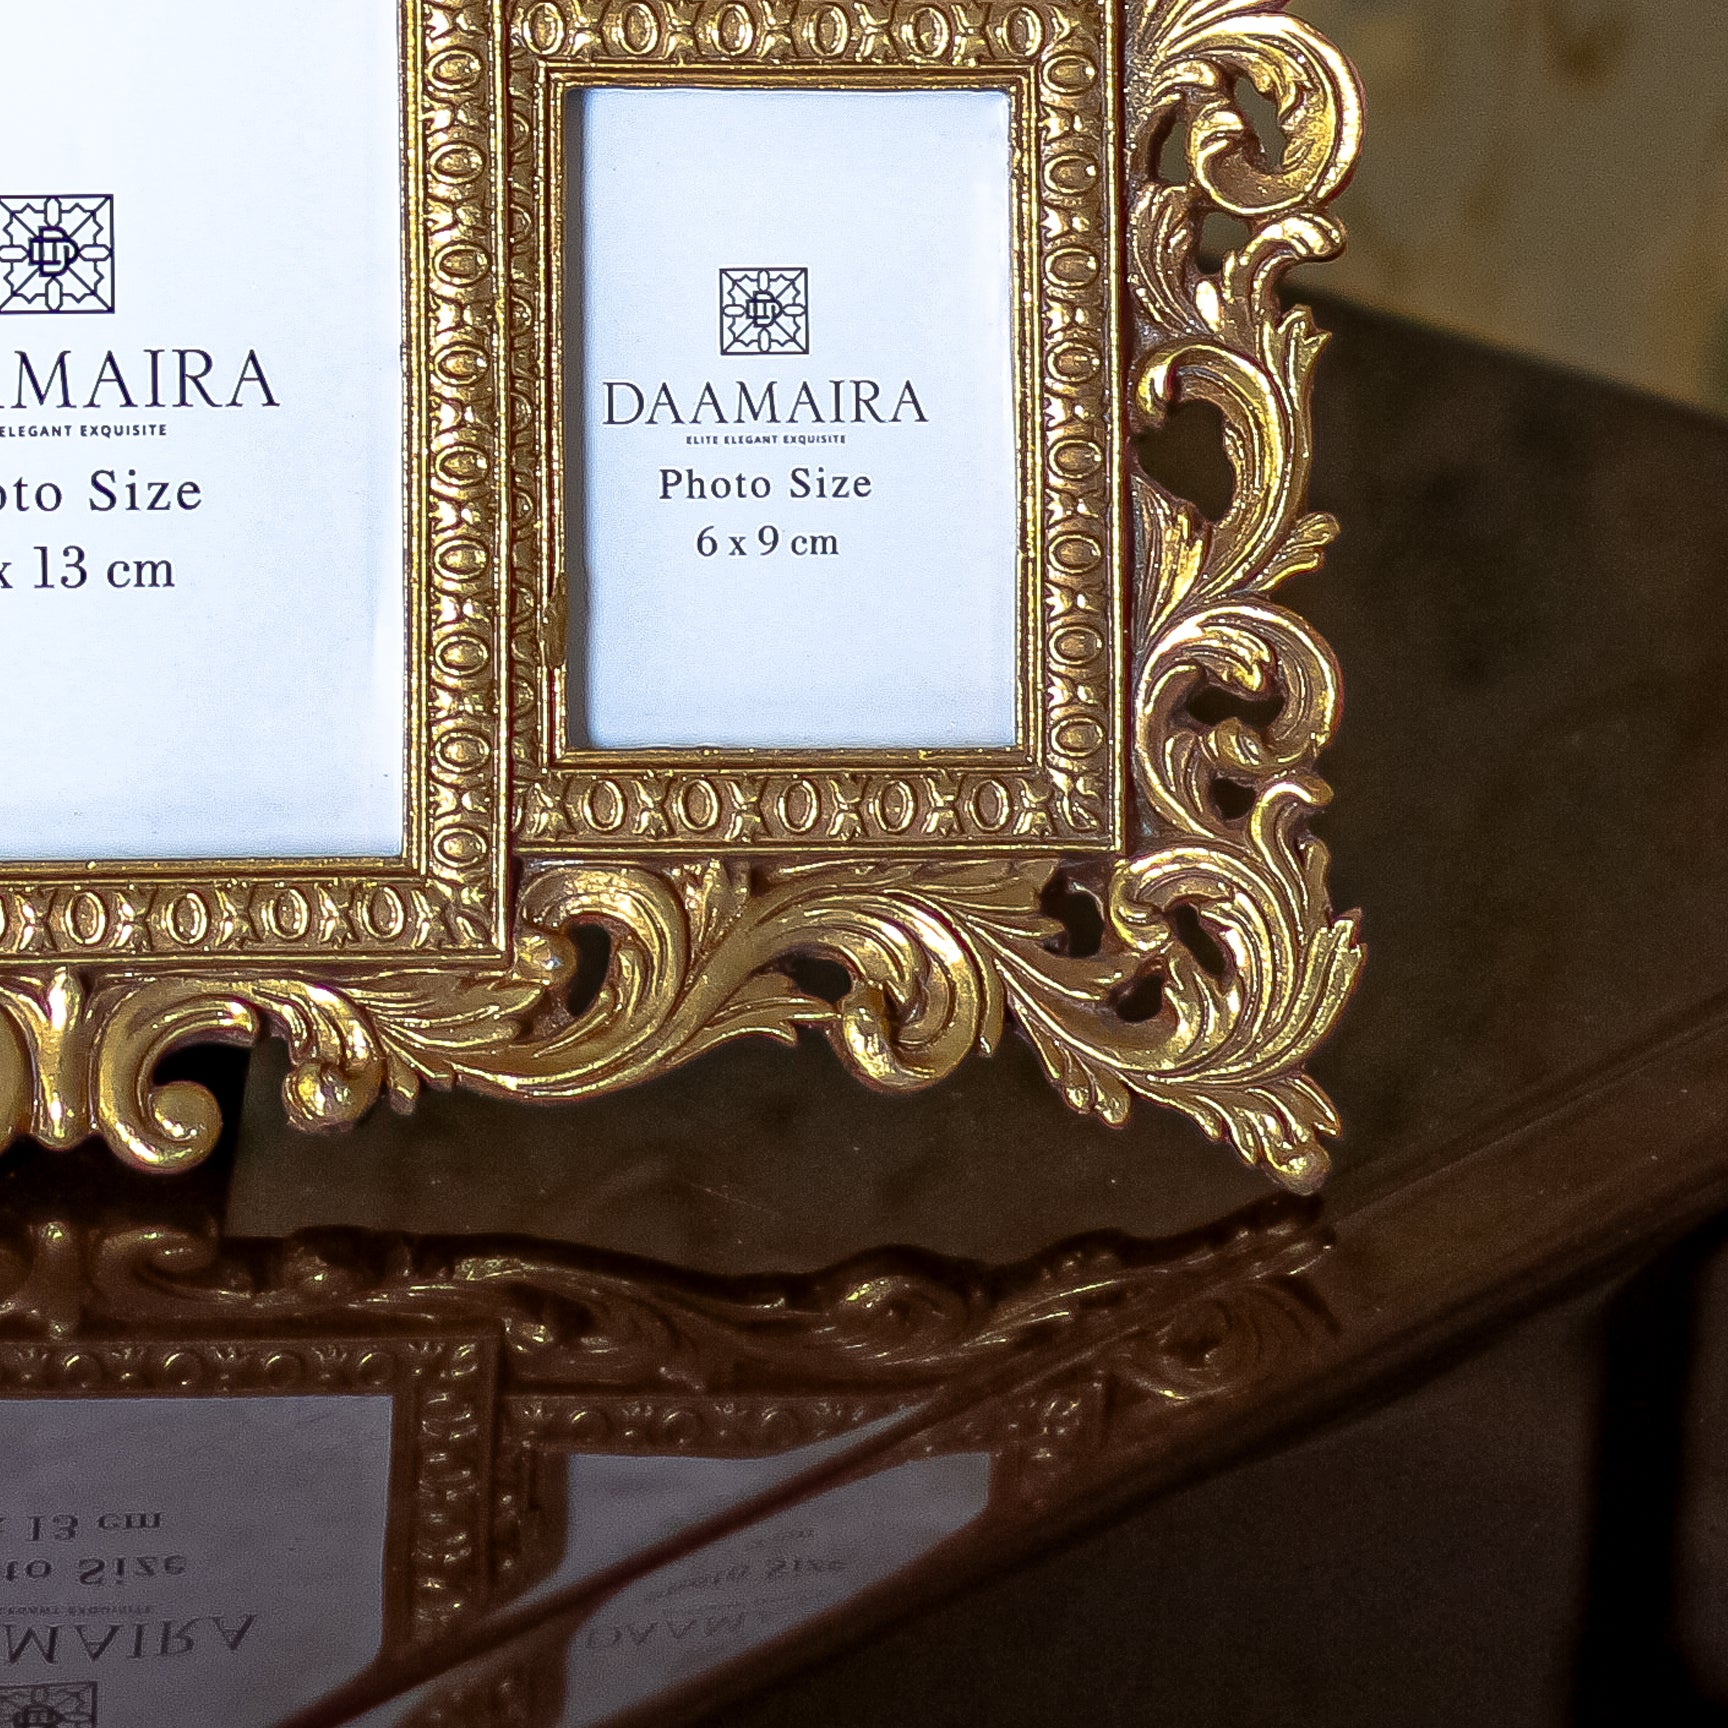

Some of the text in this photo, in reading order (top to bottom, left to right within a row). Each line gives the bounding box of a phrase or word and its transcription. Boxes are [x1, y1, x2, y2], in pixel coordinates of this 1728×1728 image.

[602, 380, 928, 424] DAAMAIRA
[0, 425, 72, 437] ELEGANT
[80, 424, 166, 438] EXQUISITE
[686, 435, 845, 445] ELITE ELEGANT EXQUISITE
[89, 469, 201, 511] Size
[660, 467, 871, 499] Photo Size
[697, 525, 839, 556] 6 x 9 cm
[34, 546, 87, 588] 13
[107, 560, 175, 588] cm
